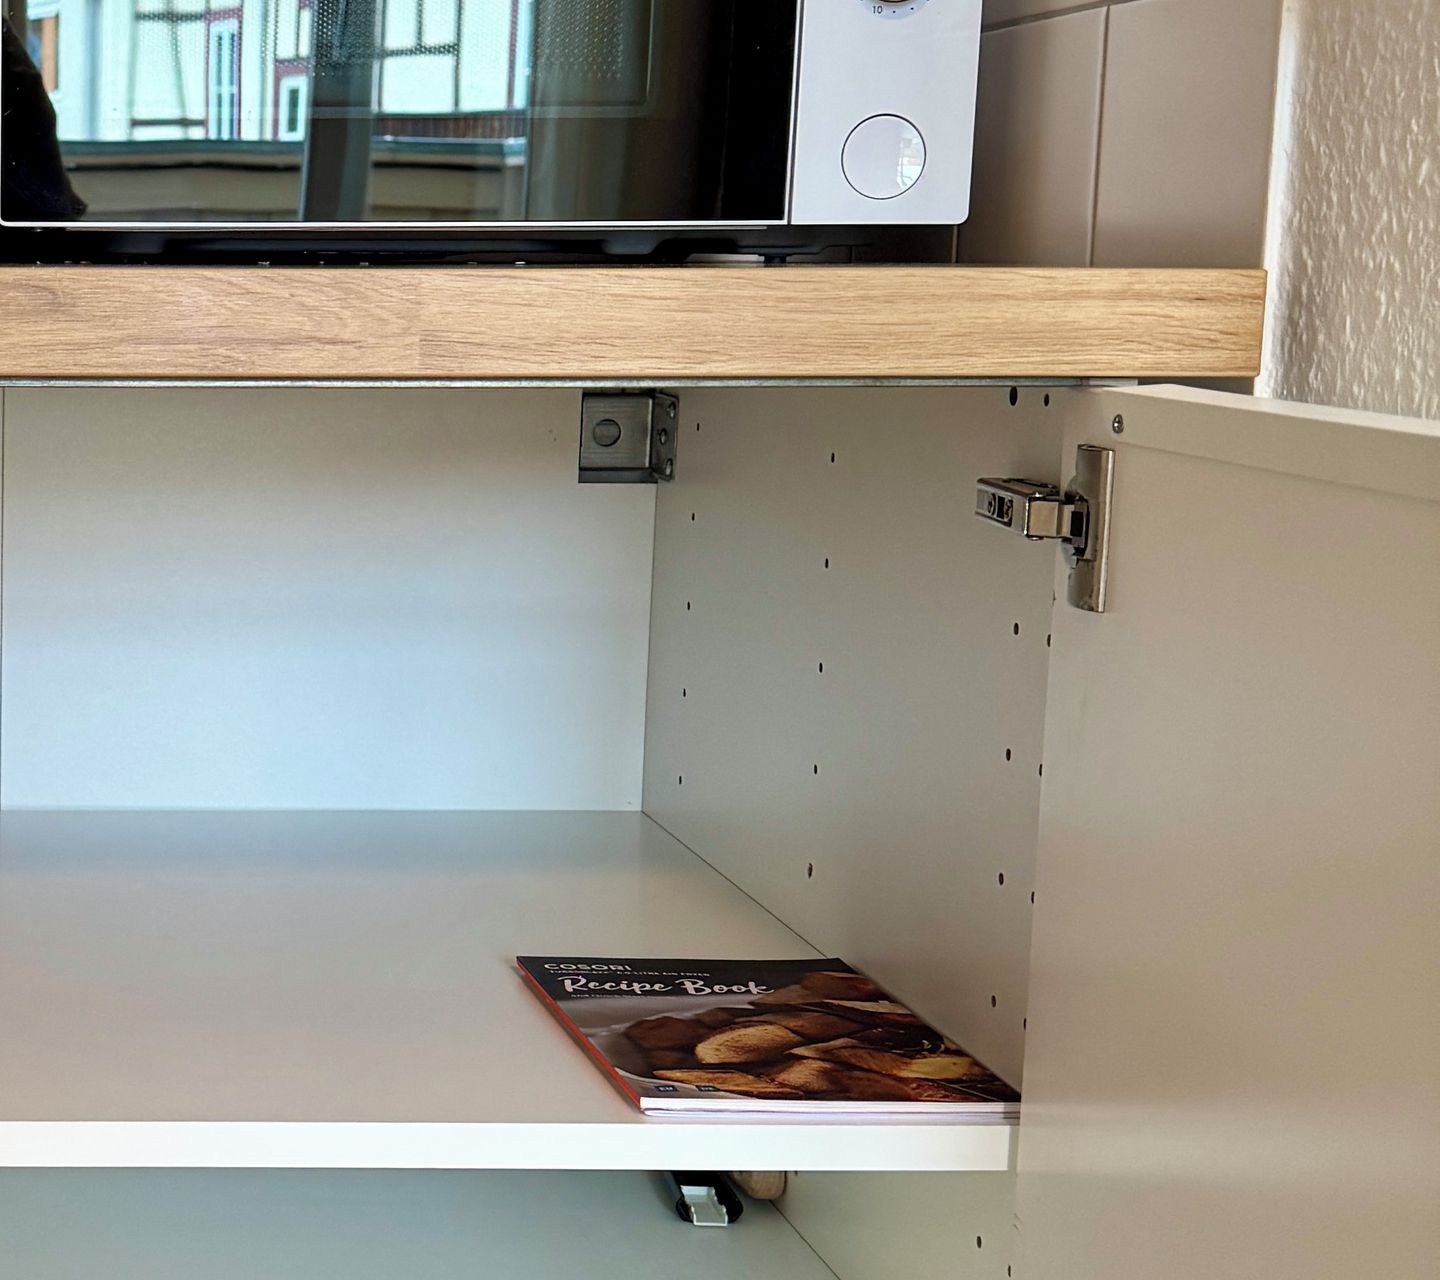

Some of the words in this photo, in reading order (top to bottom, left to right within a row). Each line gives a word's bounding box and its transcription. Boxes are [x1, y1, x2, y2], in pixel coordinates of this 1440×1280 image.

[872, 5, 883, 14] 10
[544, 963, 632, 971] COSORI
[557, 974, 674, 994] Recipe
[675, 977, 776, 996] Book
